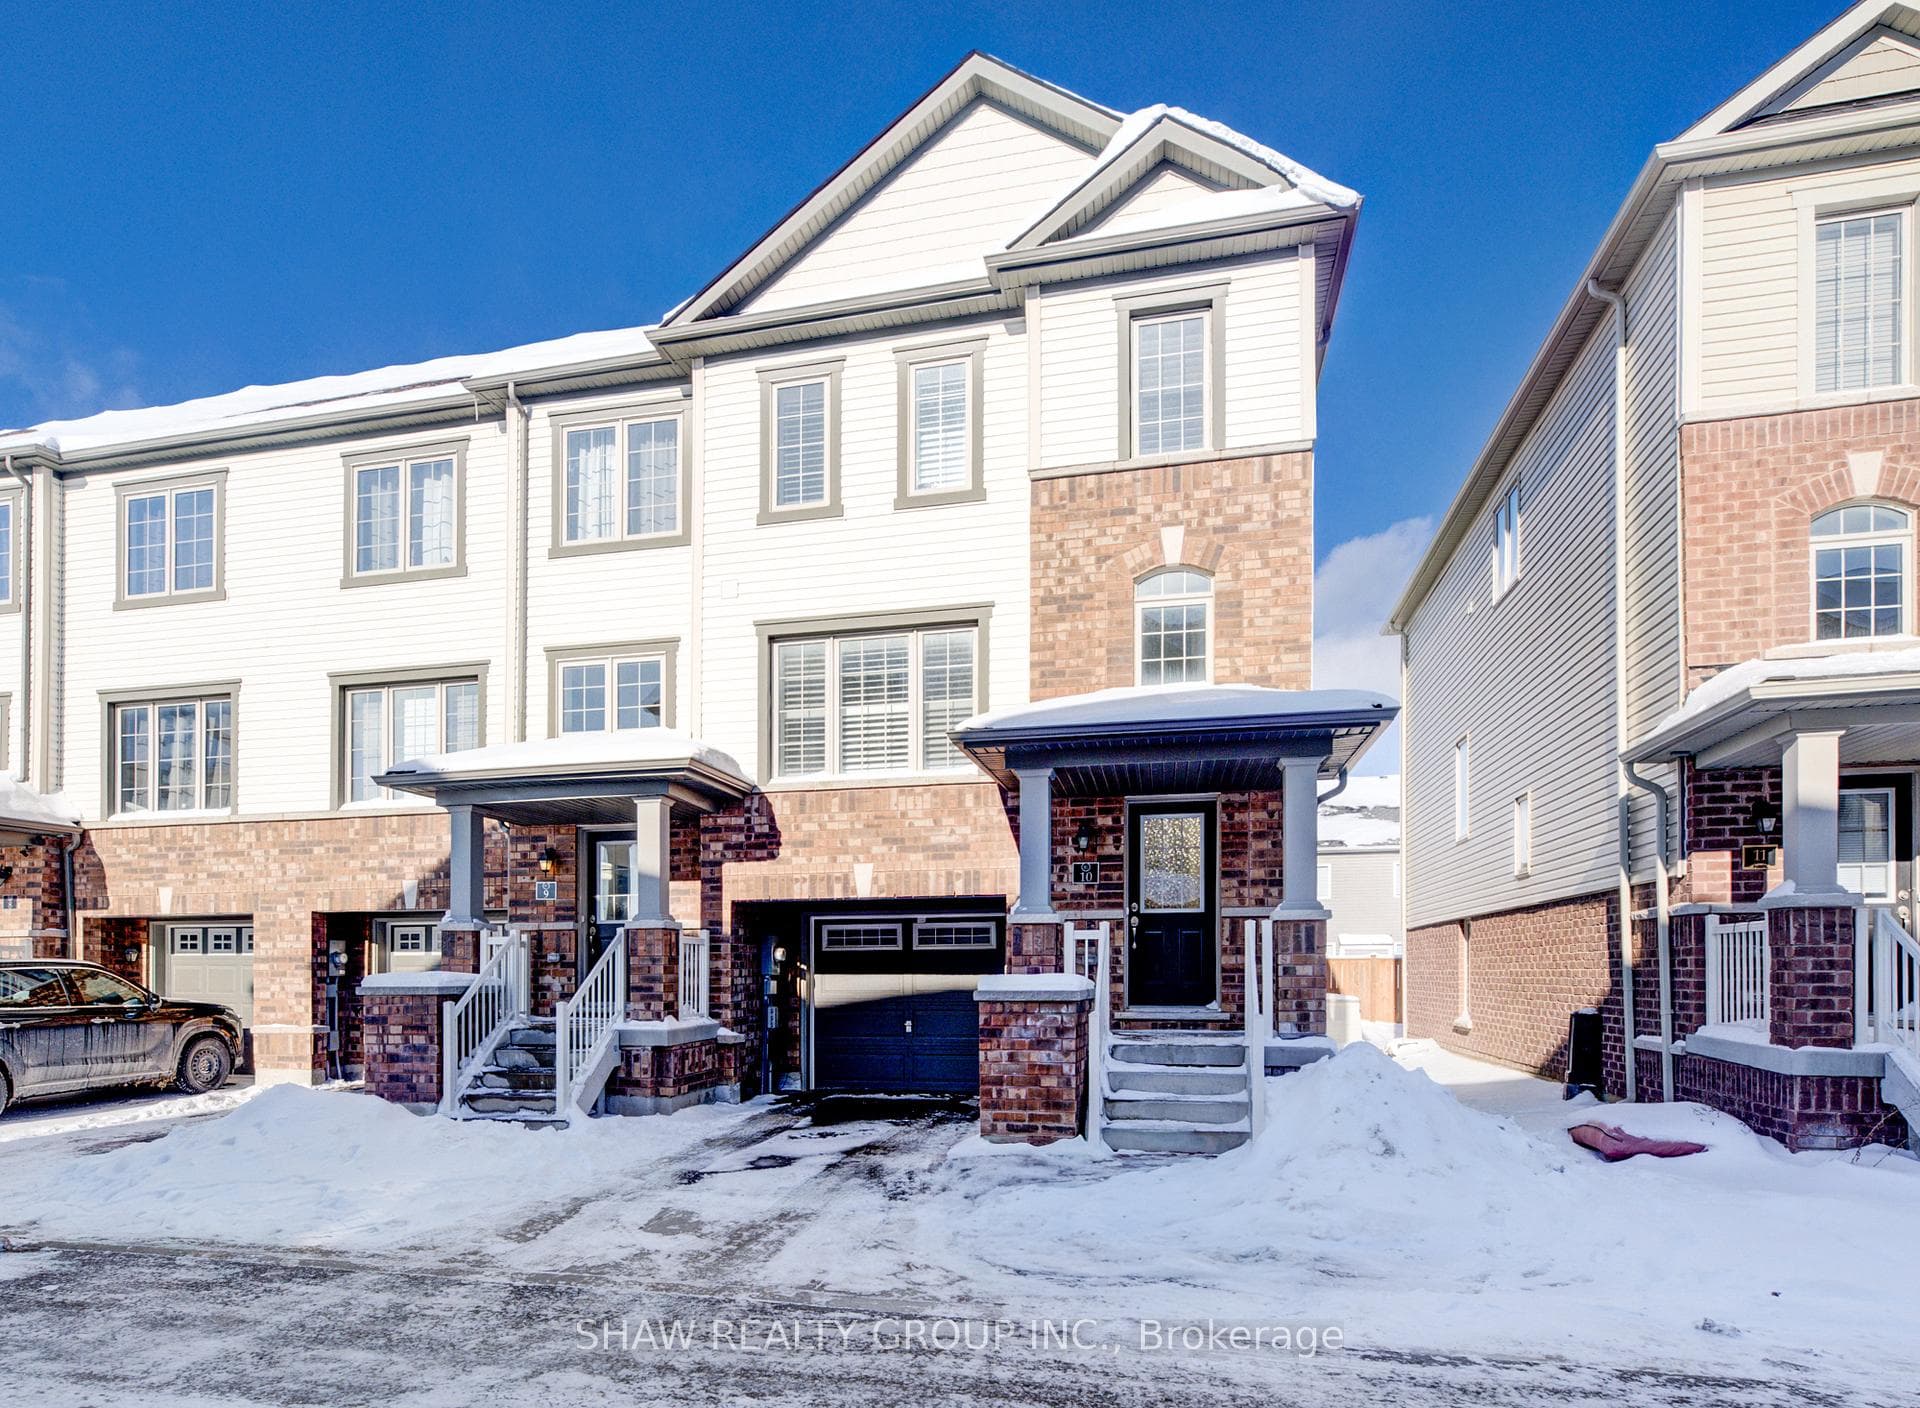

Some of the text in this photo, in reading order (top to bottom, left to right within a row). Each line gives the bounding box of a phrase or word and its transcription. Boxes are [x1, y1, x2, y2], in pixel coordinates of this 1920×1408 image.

[1753, 850, 1766, 861] 11
[1079, 871, 1093, 882] 10
[543, 889, 549, 898] 9
